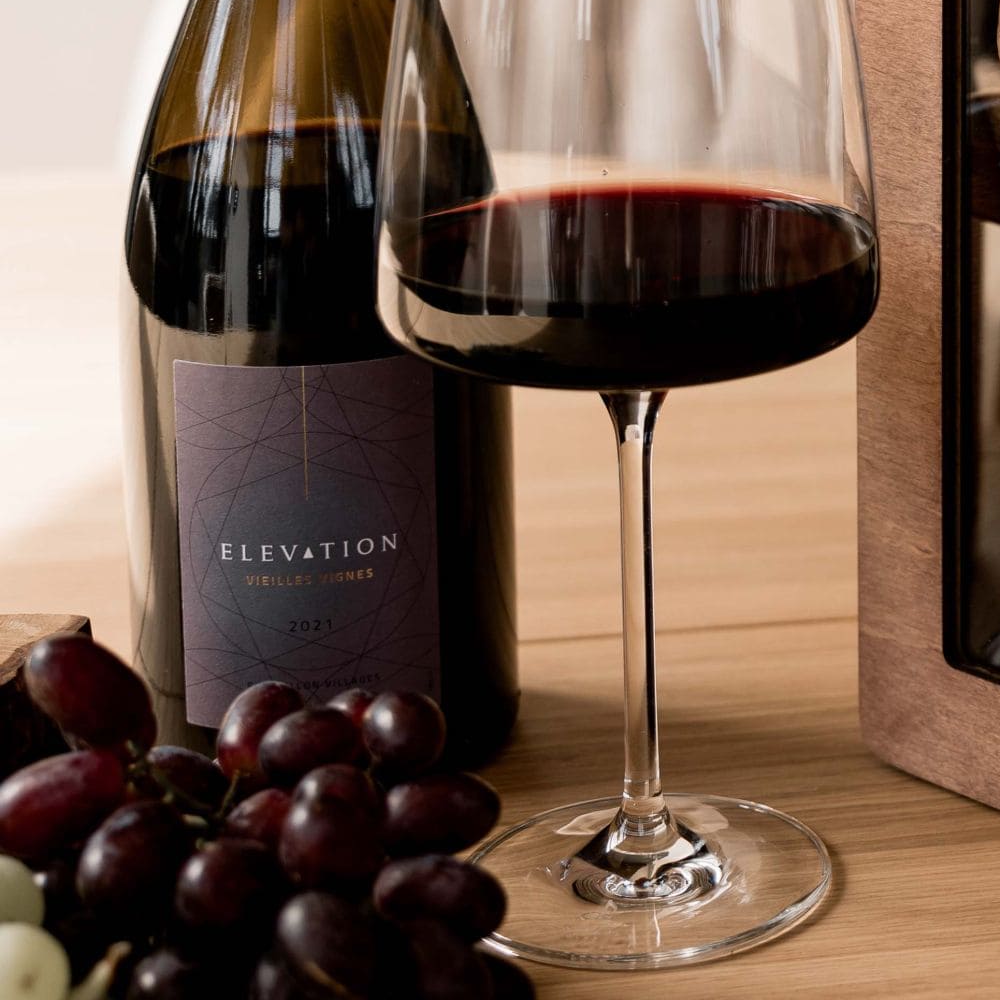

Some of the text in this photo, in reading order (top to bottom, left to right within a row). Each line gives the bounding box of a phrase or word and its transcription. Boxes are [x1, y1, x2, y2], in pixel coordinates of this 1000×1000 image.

[221, 533, 399, 563] ELEVATION
[245, 573, 312, 588] VIEILLES
[289, 618, 333, 634] 2021
